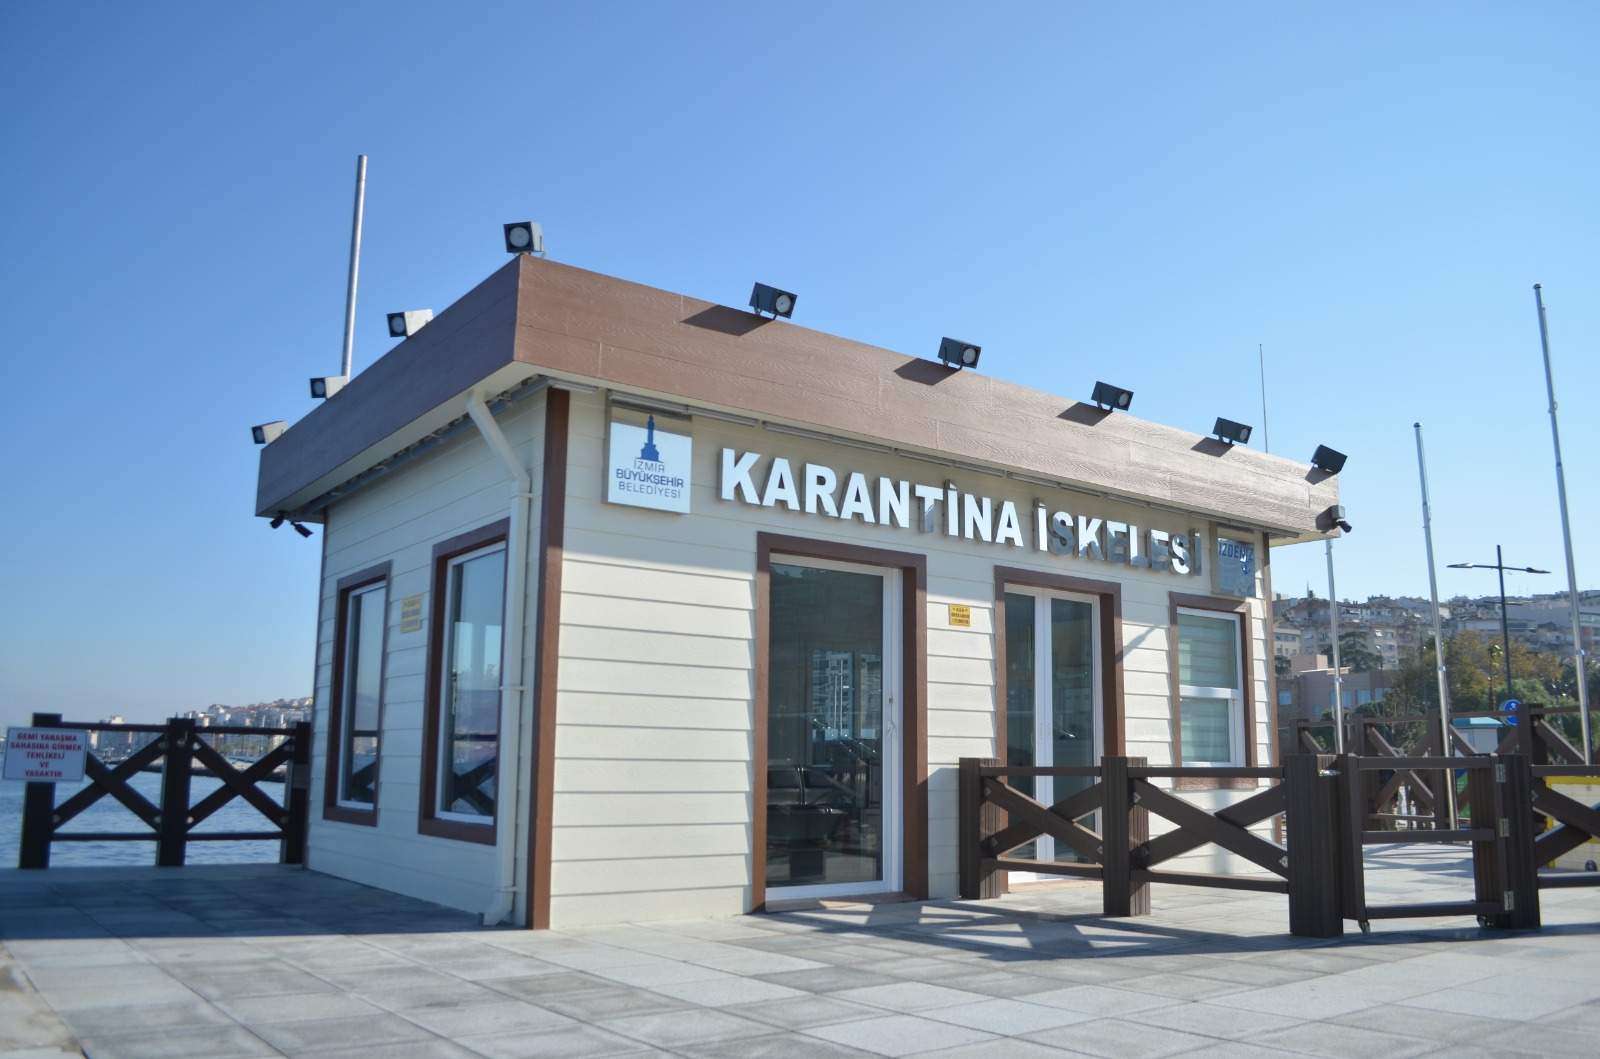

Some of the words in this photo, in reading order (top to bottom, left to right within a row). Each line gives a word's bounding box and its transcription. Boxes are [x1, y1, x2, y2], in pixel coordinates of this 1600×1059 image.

[634, 457, 665, 473] İZMİR
[616, 468, 684, 488] BÜYÜKŞEHİR
[618, 481, 680, 498] BELEDİYESİ
[720, 447, 1025, 548] KARANTİNA
[1034, 499, 1203, 577] İSKELESİ
